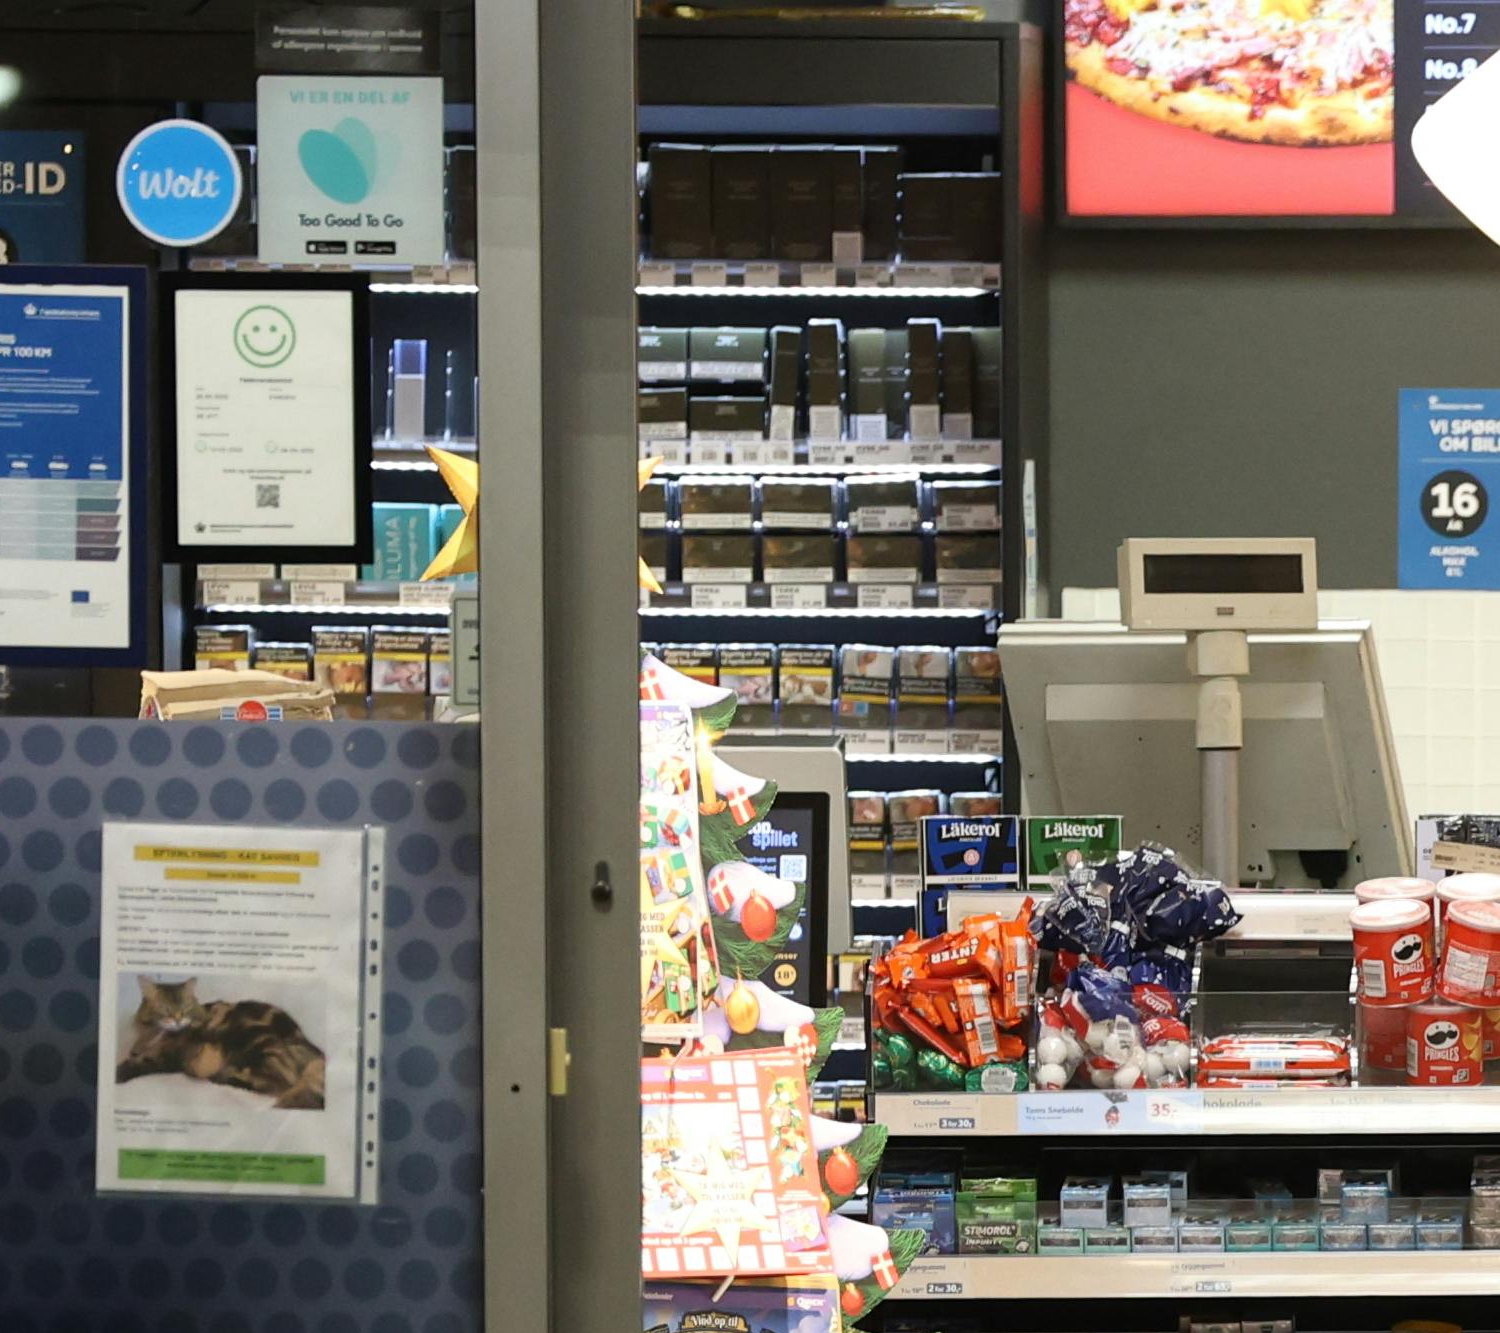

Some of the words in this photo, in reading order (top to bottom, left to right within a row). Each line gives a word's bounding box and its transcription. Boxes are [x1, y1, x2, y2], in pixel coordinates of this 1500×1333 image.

[1424, 13, 1476, 35] No.7
[138, 166, 221, 200] Wolt
[297, 213, 321, 228] Too
[324, 213, 362, 228] Good
[365, 213, 381, 228] To
[383, 213, 404, 228] Go
[1429, 418, 1449, 435] VI
[1438, 436, 1468, 453] OM
[1429, 481, 1481, 519] 16
[940, 821, 1002, 839] Läkerol
[1044, 821, 1105, 839] Läkerol
[752, 831, 798, 850] spillet
[1424, 1046, 1460, 1062] PRINGLES
[941, 1119, 948, 1128] 3
